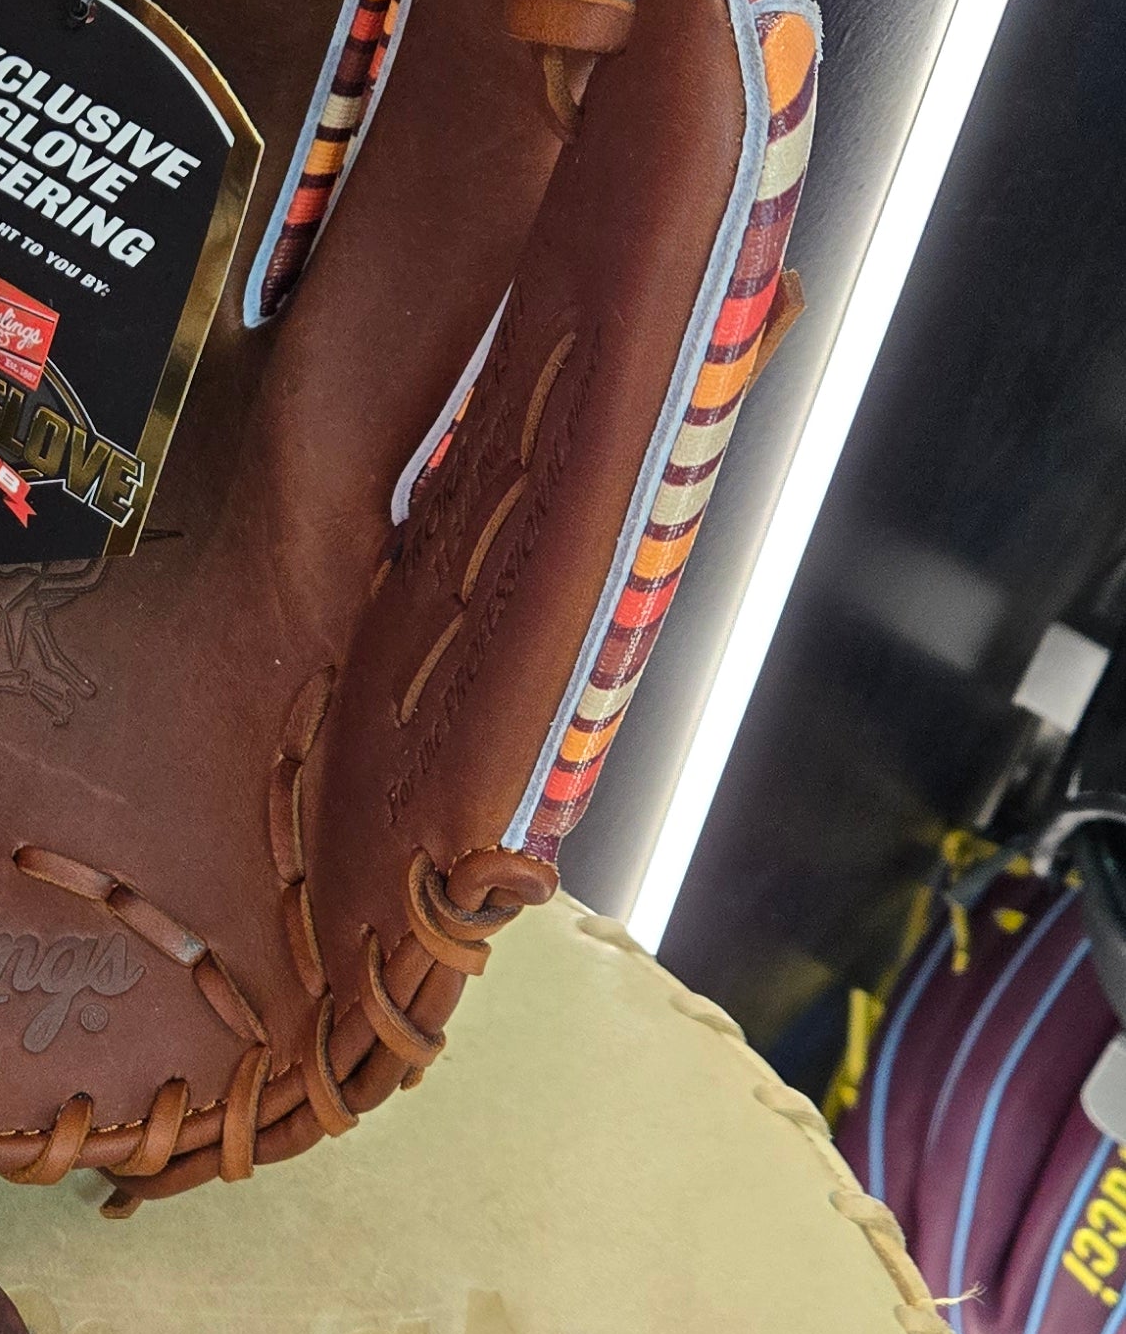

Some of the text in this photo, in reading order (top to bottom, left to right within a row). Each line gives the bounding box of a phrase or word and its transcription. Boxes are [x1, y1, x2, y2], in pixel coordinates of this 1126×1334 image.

[20, 236, 44, 256] TO
[45, 250, 82, 278] YOU
[80, 273, 111, 297] BY:
